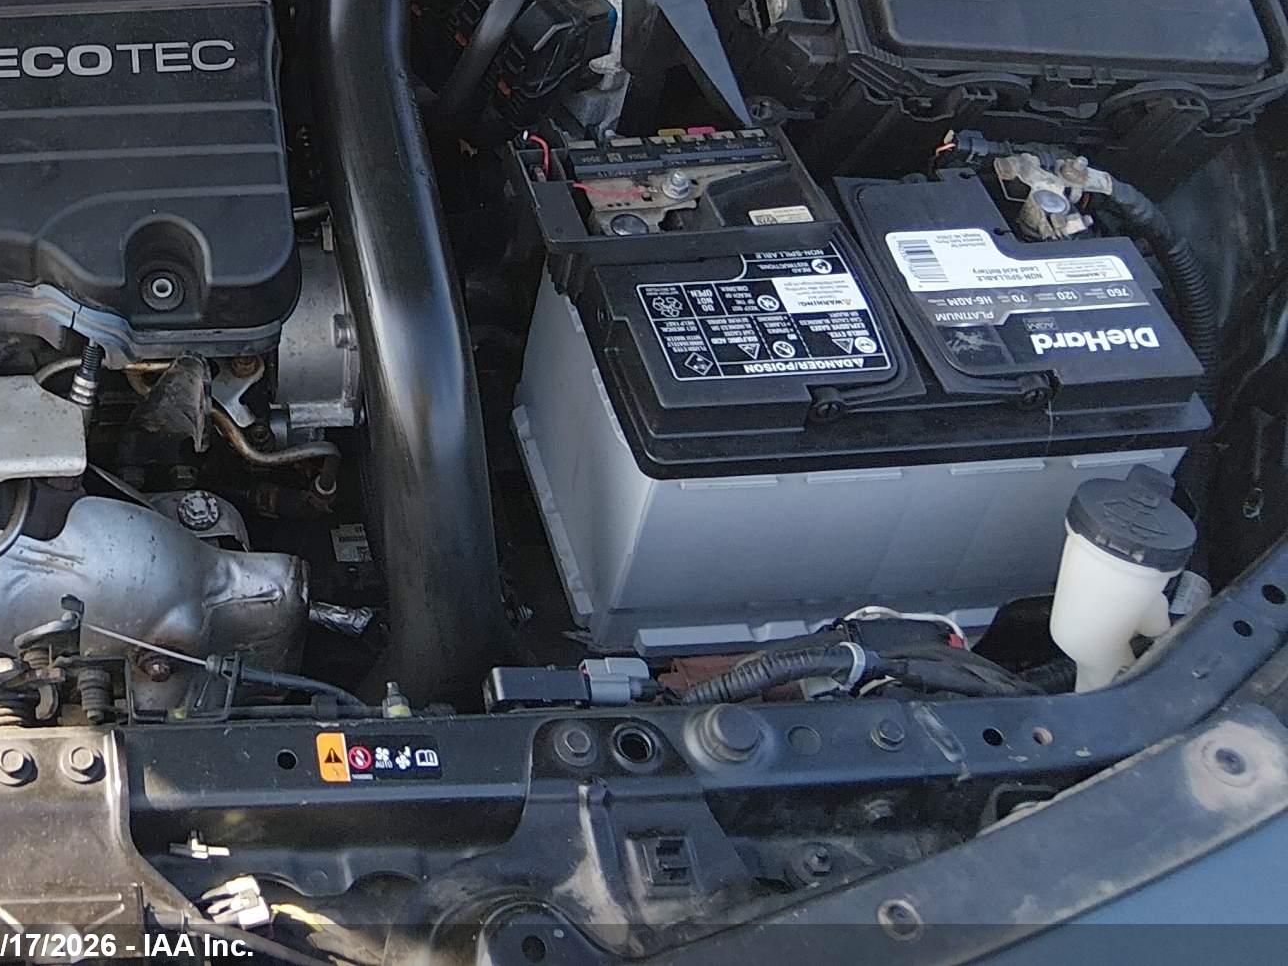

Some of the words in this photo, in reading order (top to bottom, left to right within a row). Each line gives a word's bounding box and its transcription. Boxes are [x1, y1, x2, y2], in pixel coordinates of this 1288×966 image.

[1012, 294, 1028, 303] 70
[1056, 291, 1079, 301] 120
[701, 304, 715, 312] DO
[935, 311, 995, 322] PLATINUM
[1030, 327, 1160, 355] DieHard
[743, 358, 854, 374] DANGER/POISON
[375, 760, 393, 769] AUTO
